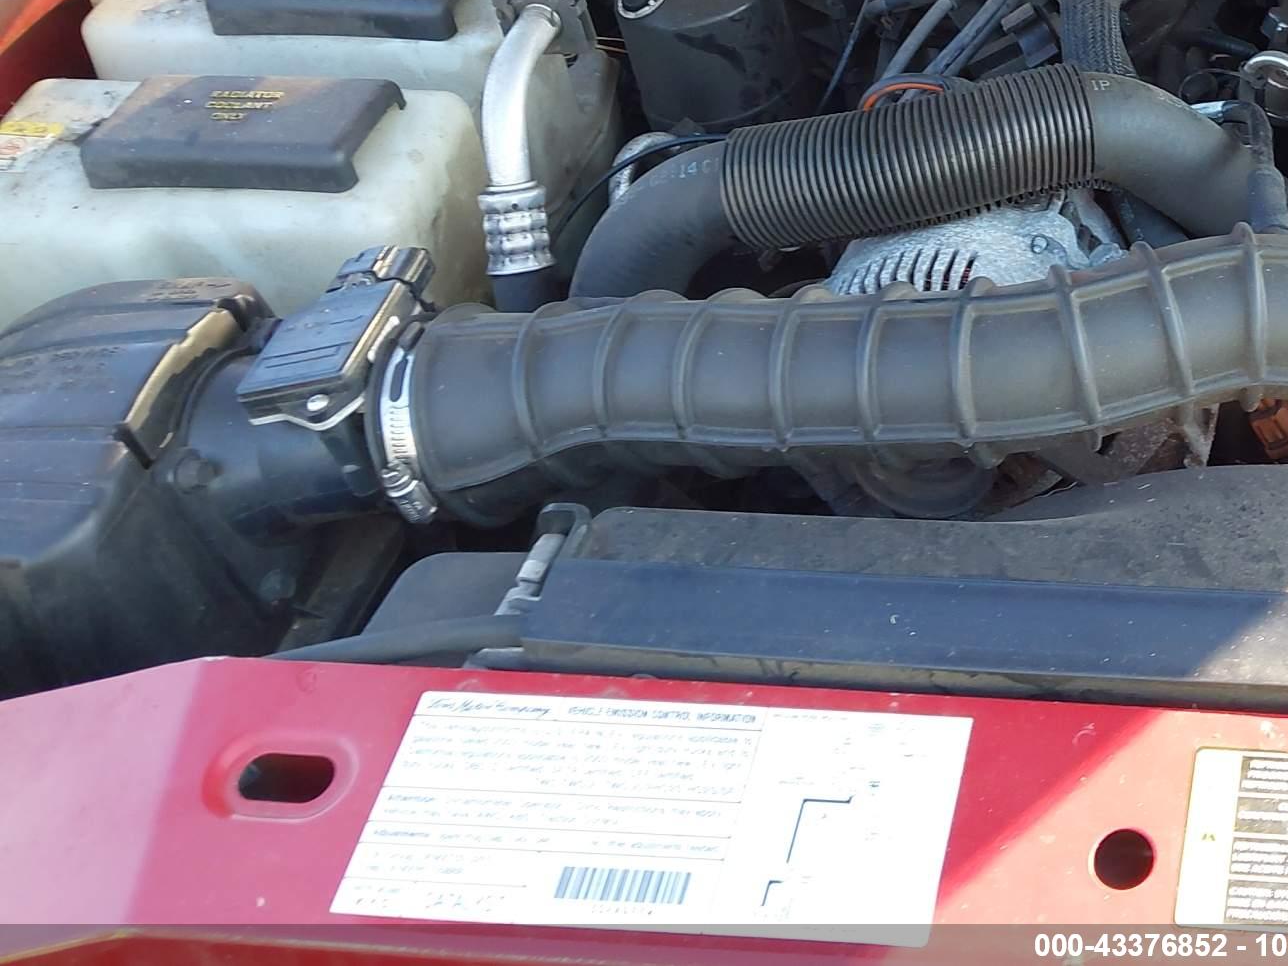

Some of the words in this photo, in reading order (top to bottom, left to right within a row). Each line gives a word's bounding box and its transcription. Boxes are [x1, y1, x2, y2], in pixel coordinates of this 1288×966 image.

[209, 90, 285, 99] RADIATOR
[204, 101, 273, 110] COOLANT
[210, 112, 246, 121] ONLY
